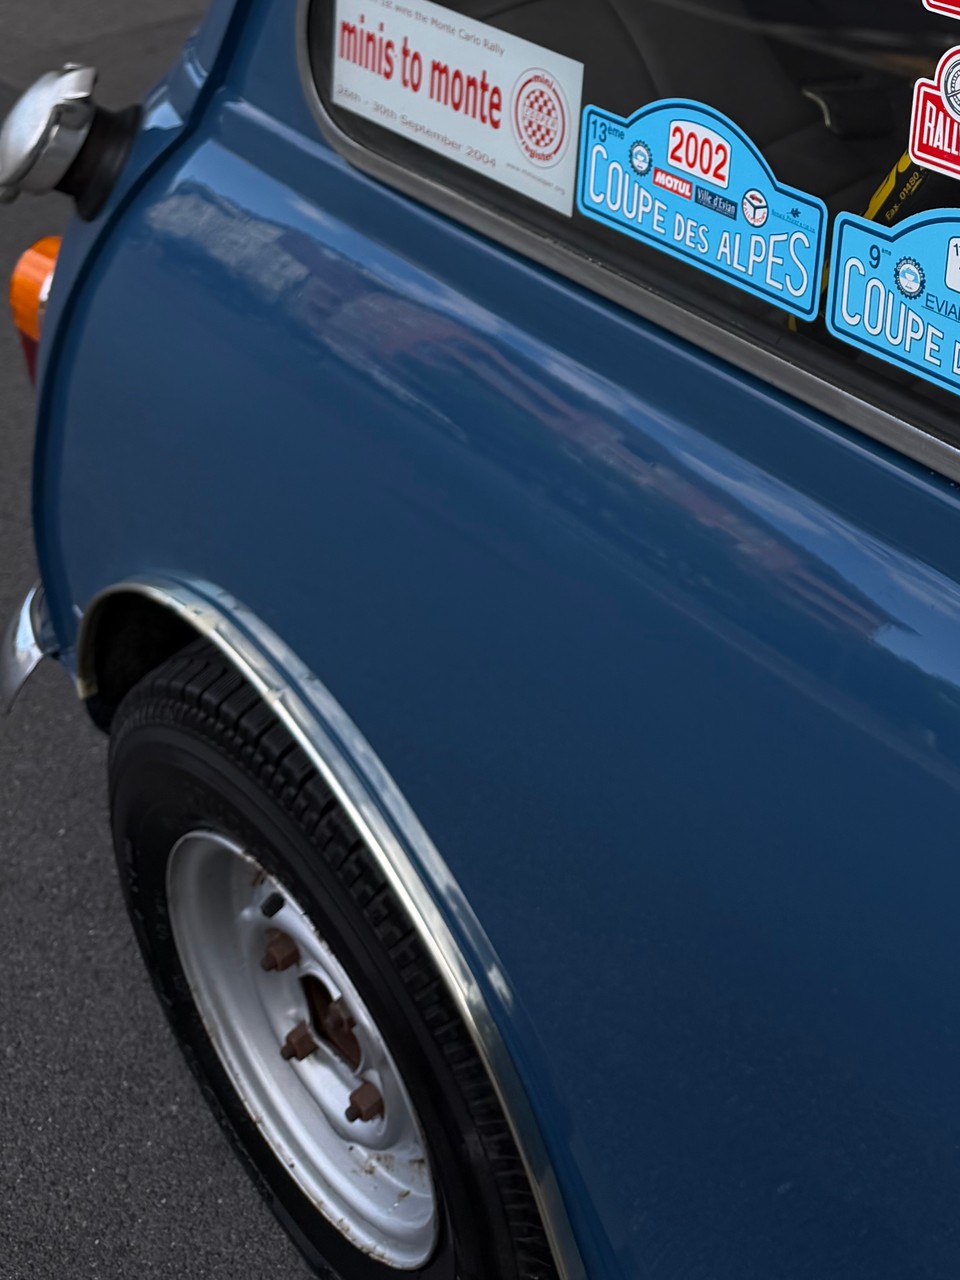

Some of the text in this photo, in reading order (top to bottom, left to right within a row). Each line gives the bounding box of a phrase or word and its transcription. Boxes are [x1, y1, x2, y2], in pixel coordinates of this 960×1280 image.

[431, 17, 456, 35] Monte
[458, 28, 482, 46] Carlo
[483, 38, 505, 57] Rally
[338, 13, 503, 130] minis to monte
[399, 113, 463, 150] September
[669, 125, 729, 183] 2002
[655, 171, 692, 197] MOTUL
[588, 143, 668, 235] COUPE
[673, 211, 710, 255] DES
[715, 230, 811, 298] ALPES
[840, 256, 945, 368] COUPE
